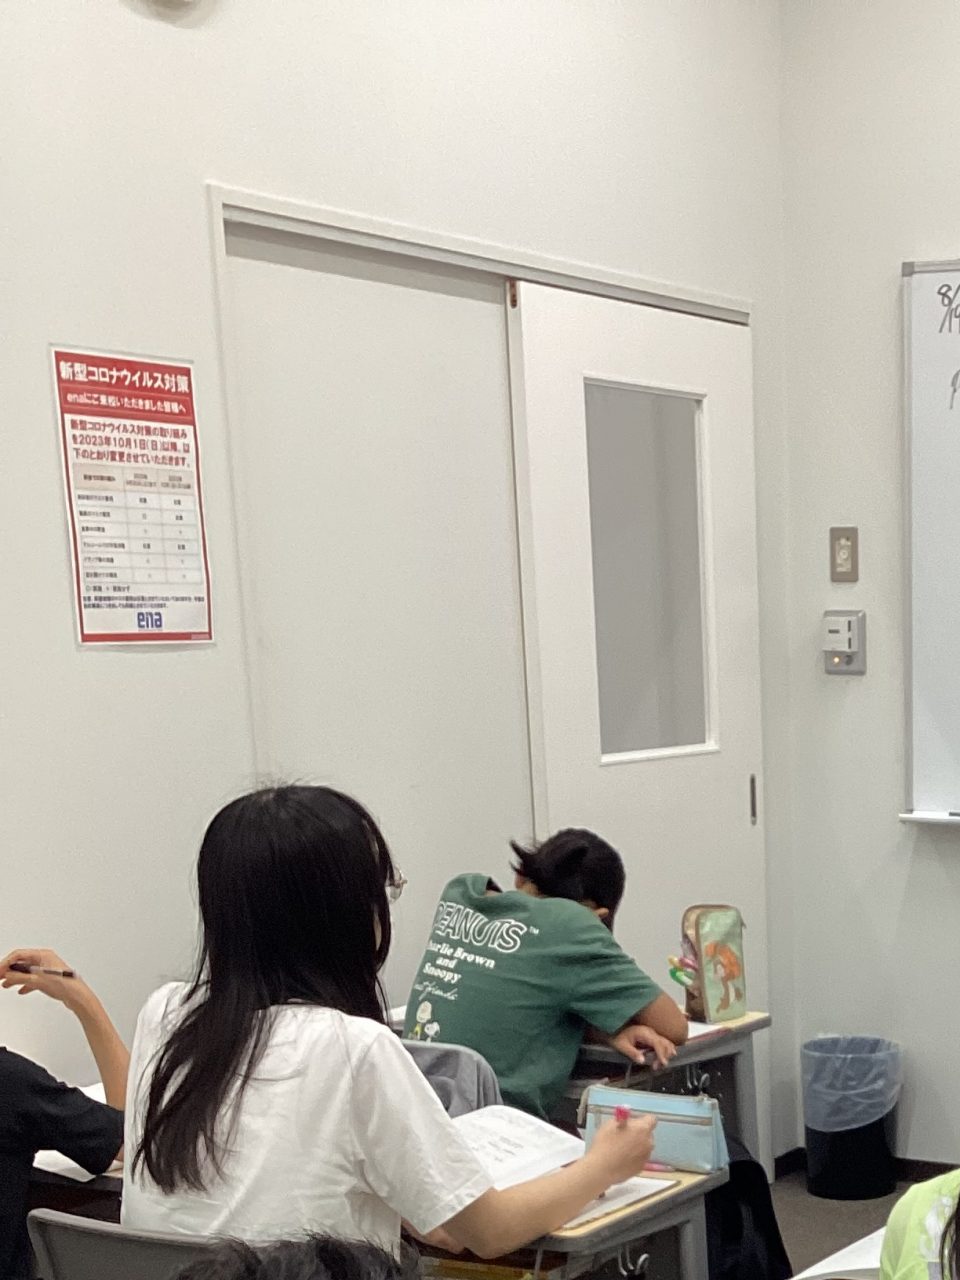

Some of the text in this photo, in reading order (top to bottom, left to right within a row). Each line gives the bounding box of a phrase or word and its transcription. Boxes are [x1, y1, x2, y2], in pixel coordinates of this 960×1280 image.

[59, 361, 189, 393] 新型コロナウイルス対策
[136, 611, 163, 629] ena
[435, 956, 458, 969] and
[454, 947, 496, 970] Brown
[422, 962, 462, 984] Snoopy
